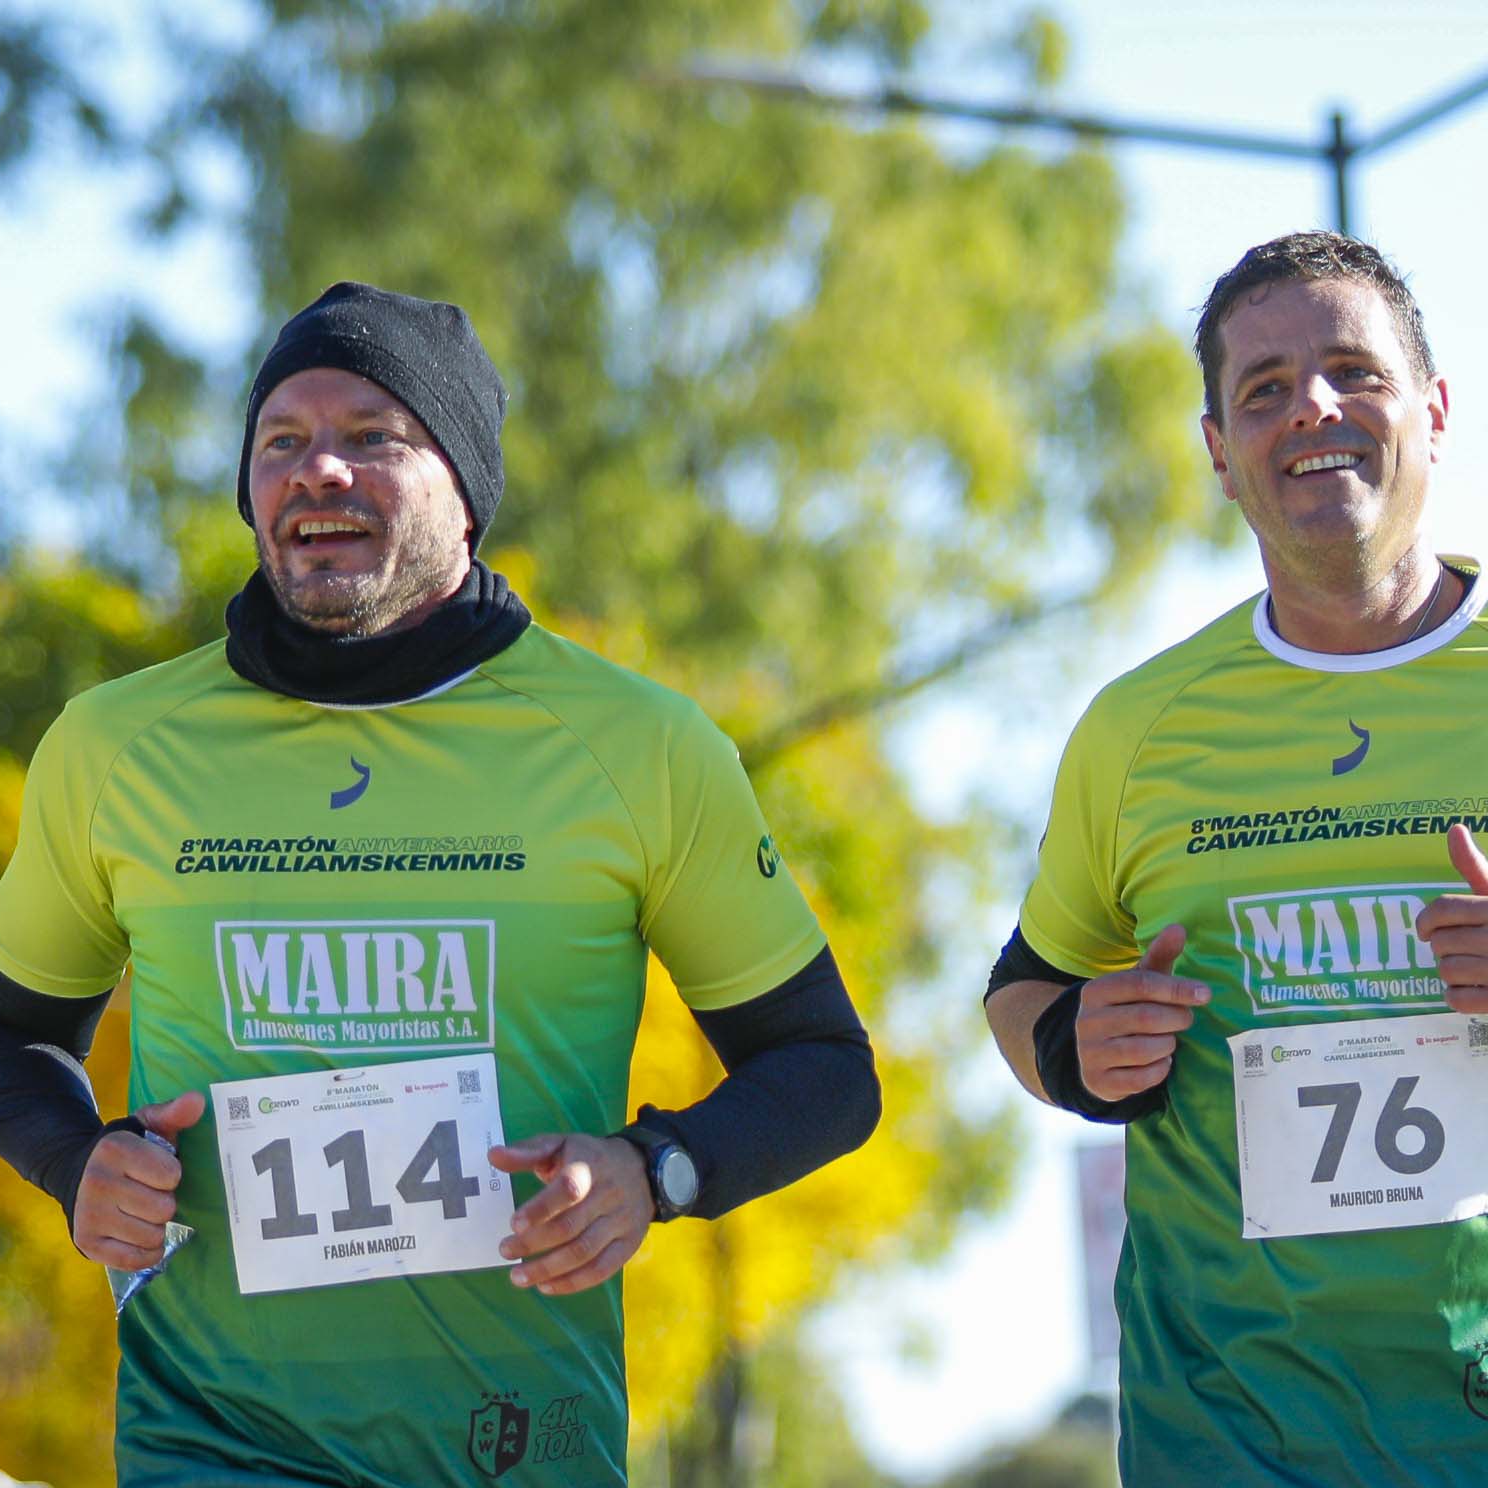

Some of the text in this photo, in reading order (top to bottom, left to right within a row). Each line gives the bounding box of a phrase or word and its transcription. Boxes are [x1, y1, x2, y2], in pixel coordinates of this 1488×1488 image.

[175, 852, 526, 874] CAWILLIAMSKEMMIS
[1245, 894, 1437, 979] MAIR
[231, 932, 478, 1014] MAIRA
[1261, 984, 1350, 1003] Almacenes
[243, 1018, 479, 1042] Almacenes Mayoristas S.A.
[1323, 1048, 1406, 1062] CAWILLIAMSKEMMIS
[312, 1097, 394, 1112] CAWILLIAMSKEMMIS
[1297, 1075, 1445, 1183] 76
[251, 1119, 480, 1240] 114
[1329, 1186, 1424, 1208] MAURICIO BRUNA
[323, 1235, 416, 1260] FABIÁN MAROZZI
[539, 1394, 583, 1430] 4K
